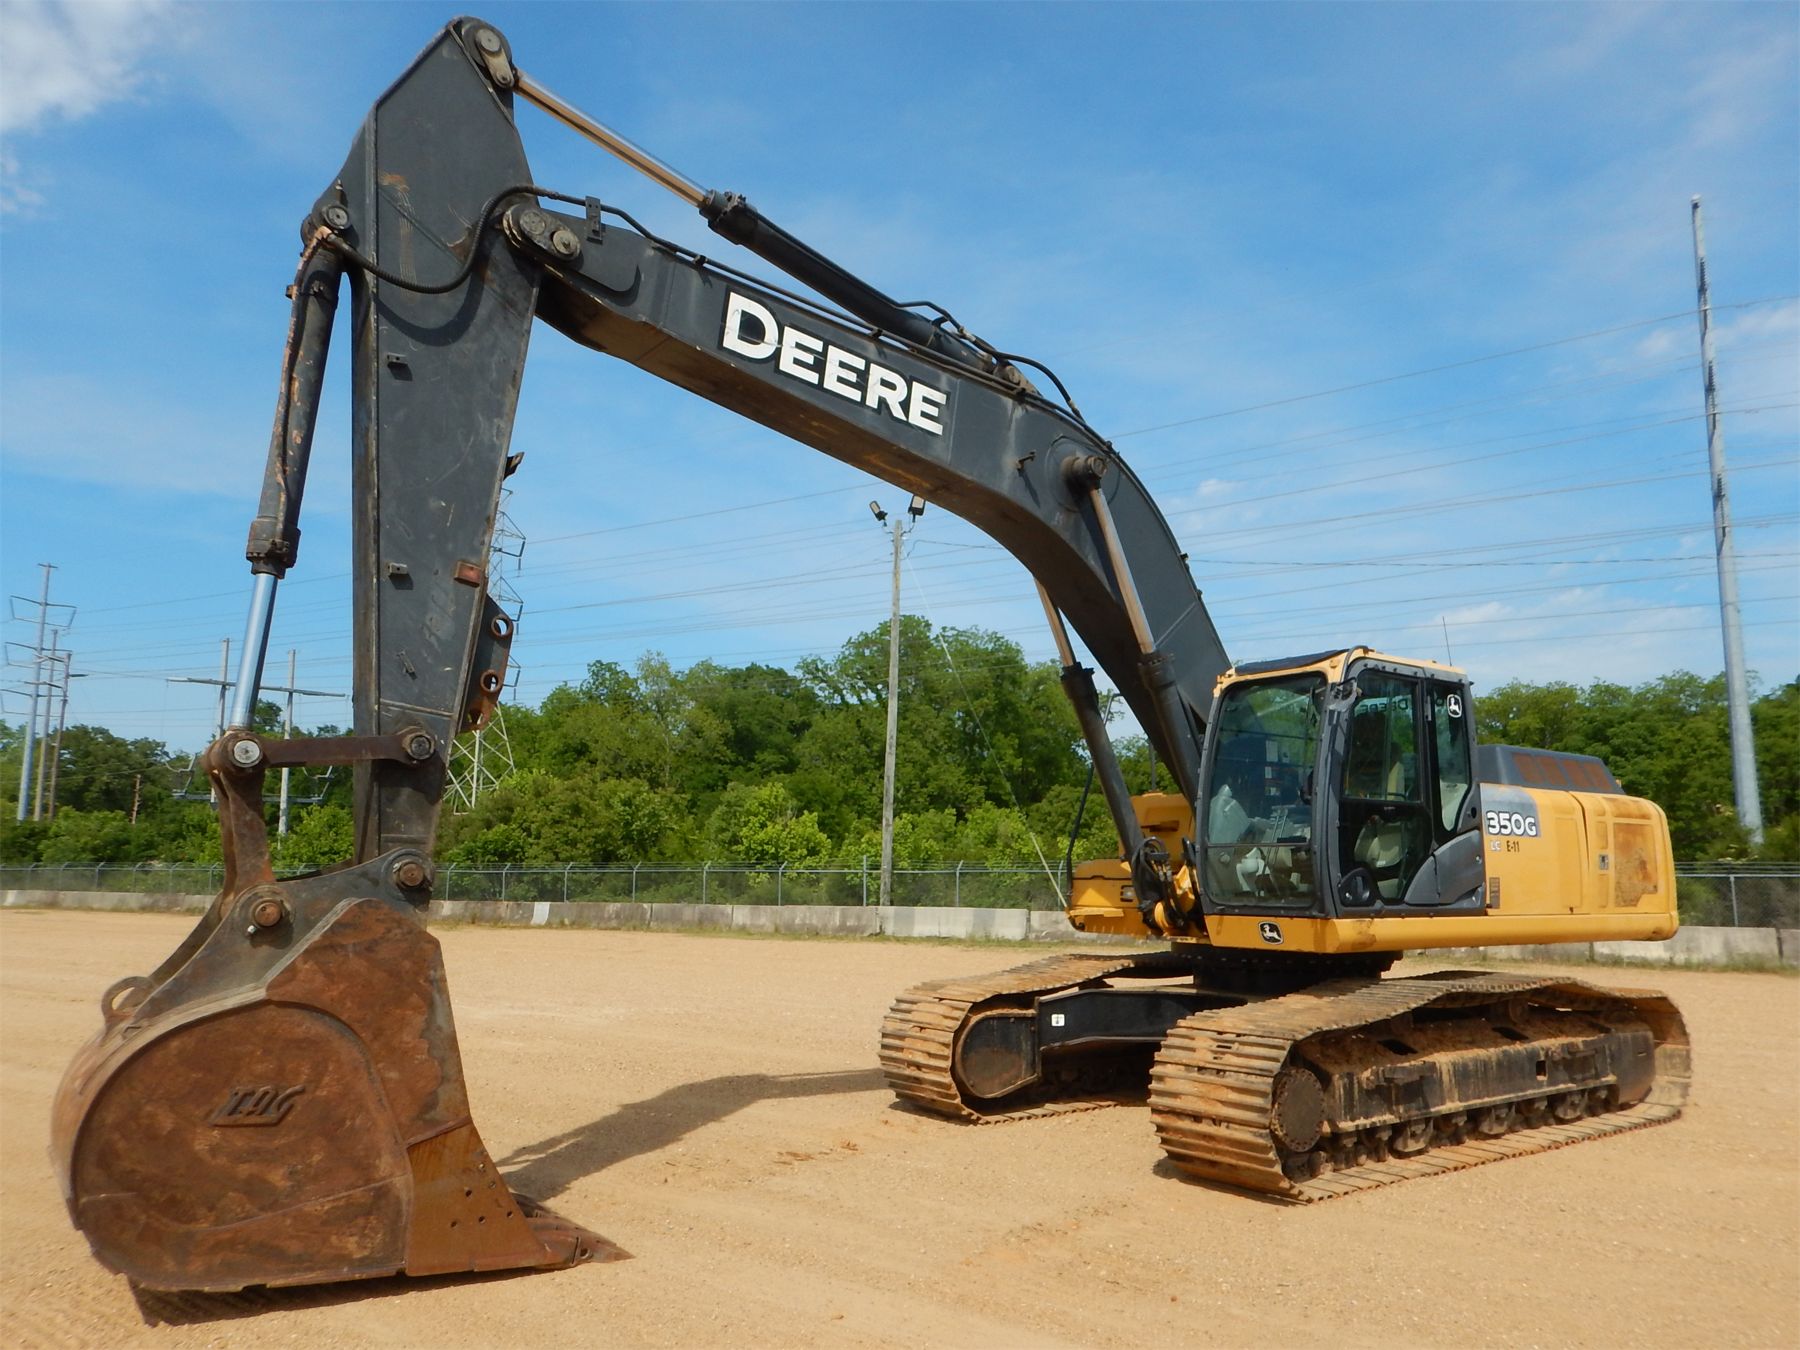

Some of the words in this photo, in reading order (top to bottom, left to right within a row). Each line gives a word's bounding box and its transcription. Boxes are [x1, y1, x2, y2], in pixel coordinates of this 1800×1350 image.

[723, 291, 947, 436] DEERE
[1486, 810, 1537, 837] 350G
[1490, 840, 1501, 852] LC
[1506, 840, 1520, 852] E-11
